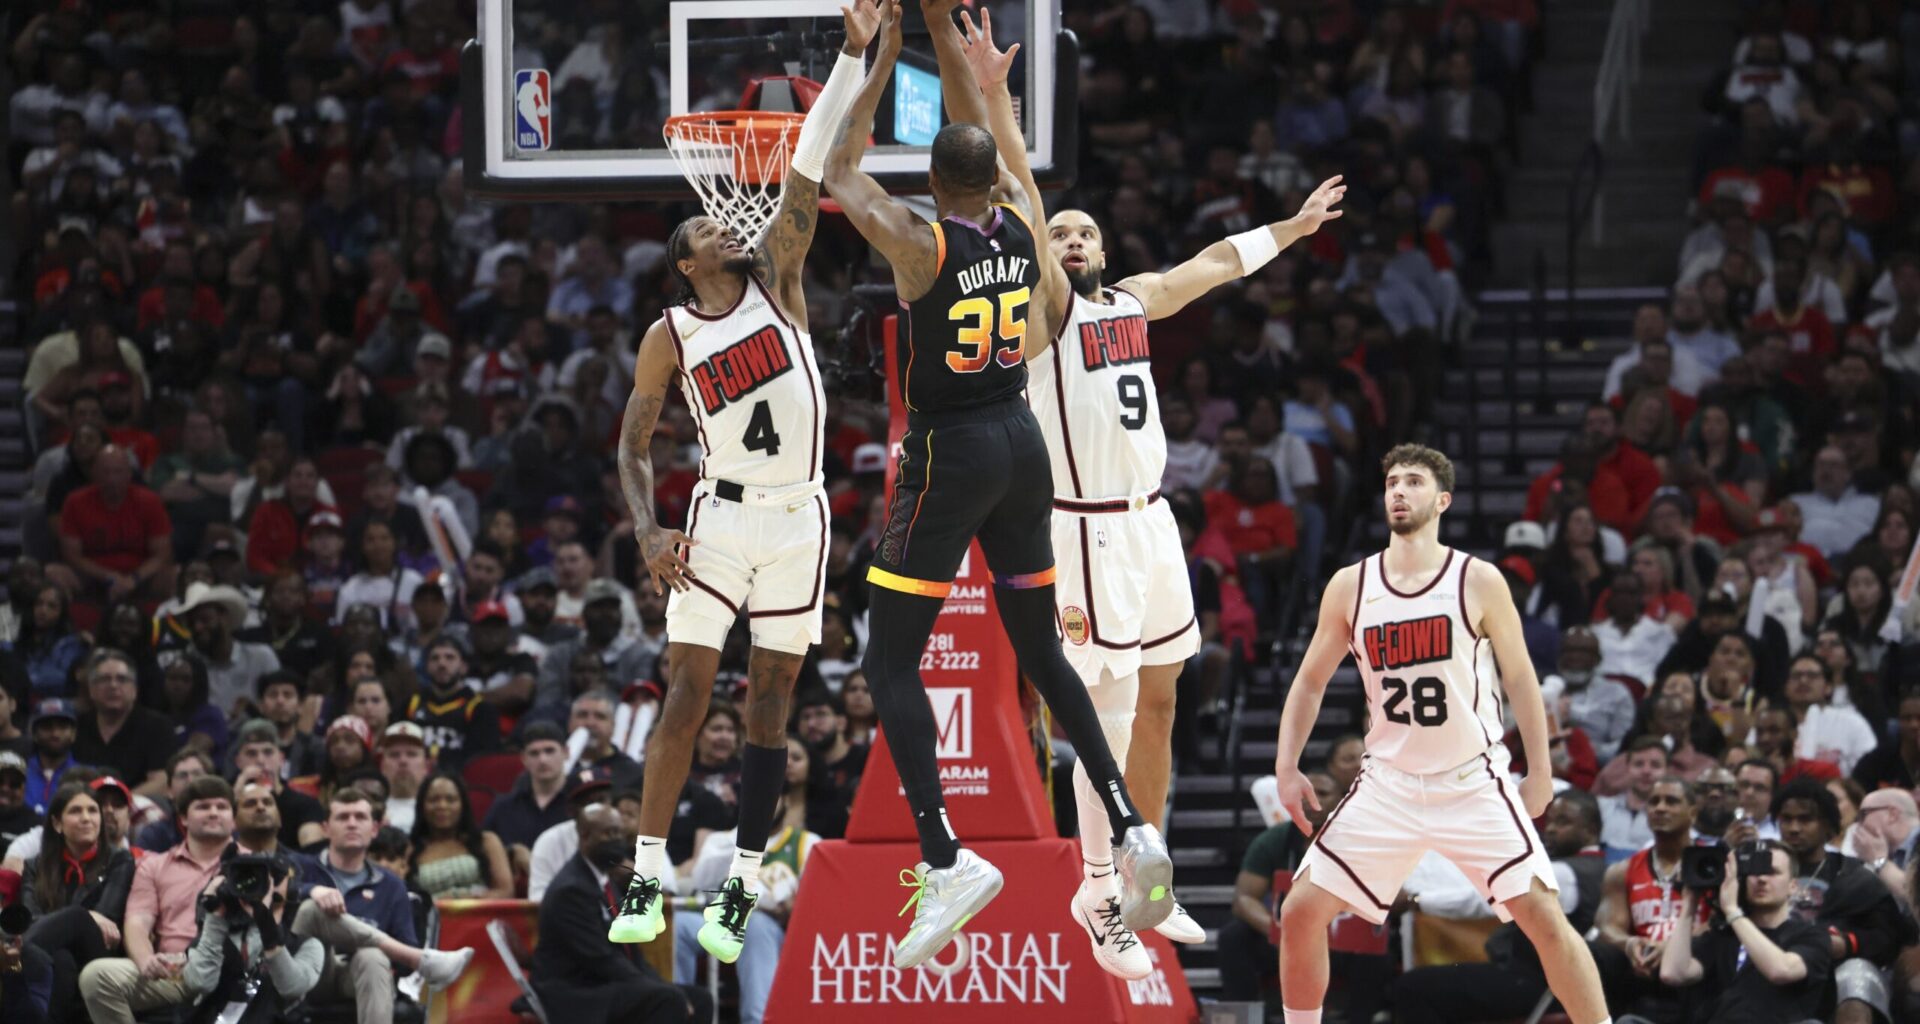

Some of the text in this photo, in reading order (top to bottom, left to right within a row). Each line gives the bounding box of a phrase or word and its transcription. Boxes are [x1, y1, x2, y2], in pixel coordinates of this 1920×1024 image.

[520, 132, 538, 146] NBA
[957, 256, 1030, 295] DURANT
[945, 286, 1030, 373] 35
[1116, 374, 1148, 431] 9
[741, 399, 781, 457] 4
[939, 604, 987, 615] AWYERS
[1381, 676, 1448, 727] 28
[941, 786, 990, 796] AWYERS
[811, 932, 1071, 974] MEORIAL
[811, 967, 1068, 1004] HERMANN
